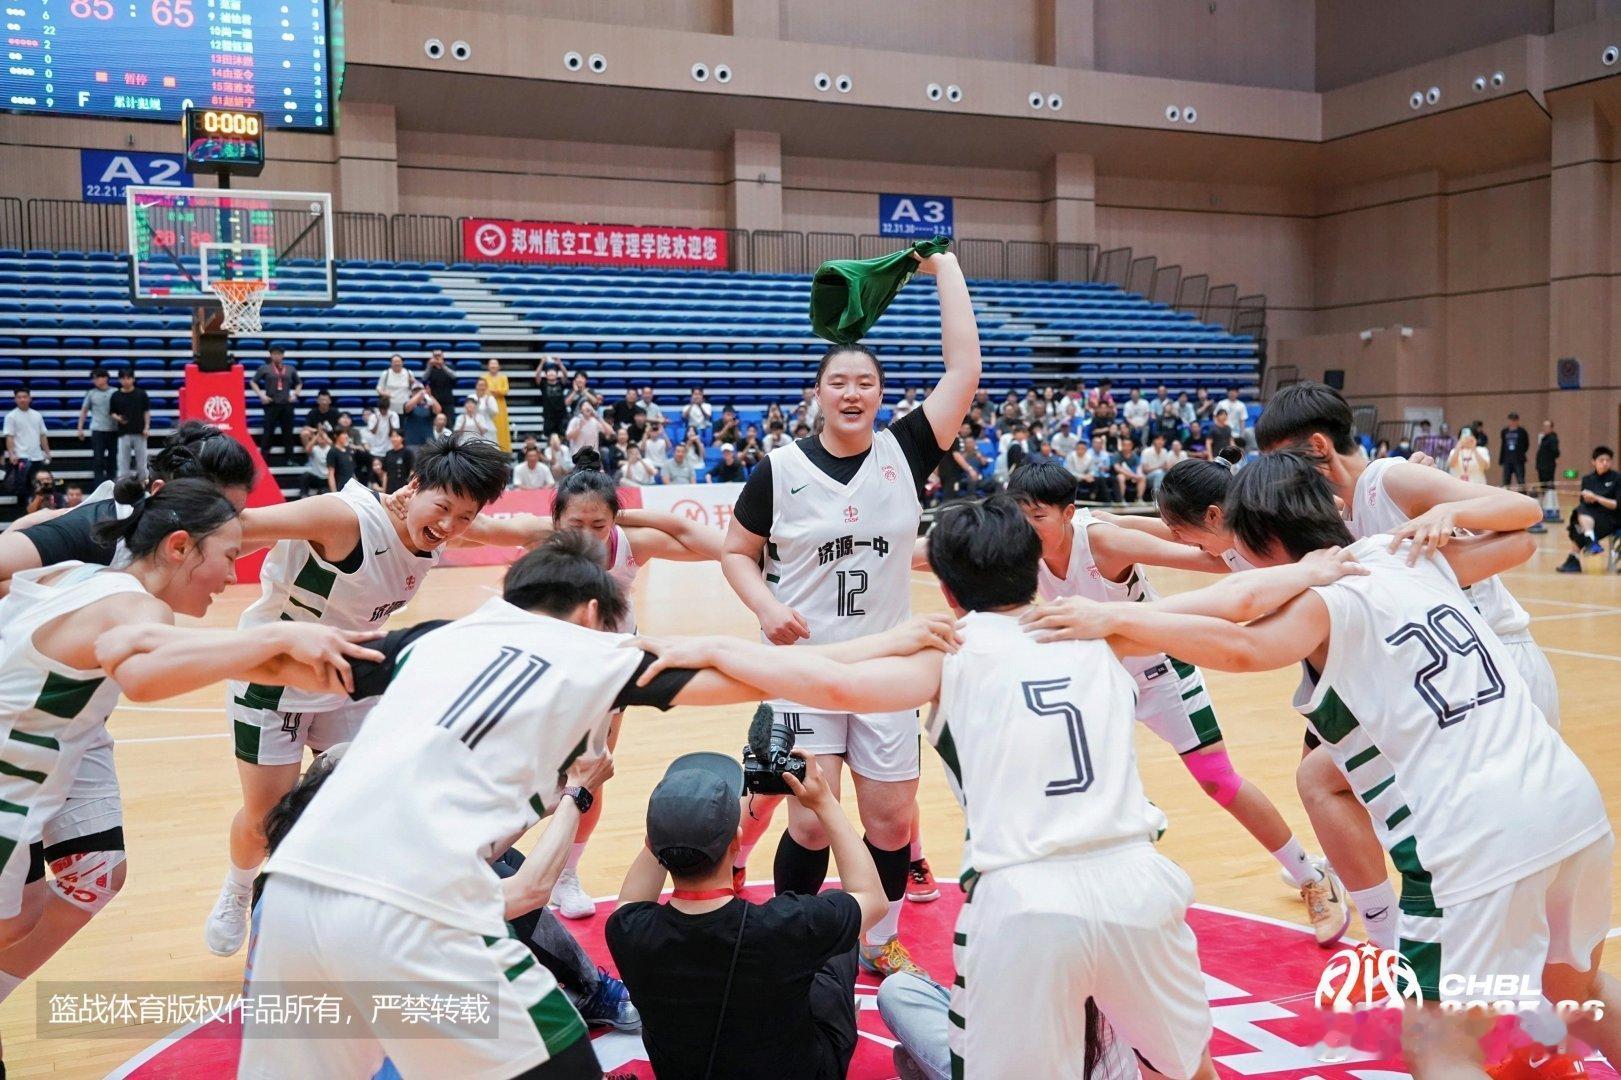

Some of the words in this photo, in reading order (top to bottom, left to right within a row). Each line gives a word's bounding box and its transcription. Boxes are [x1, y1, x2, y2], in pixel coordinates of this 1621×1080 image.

[151, 0, 196, 28] 65
[43, 26, 56, 36] 22
[43, 40, 51, 50] 2
[78, 91, 91, 107] F
[99, 155, 182, 186] A2
[890, 198, 945, 223] A3
[511, 228, 718, 261] 郑州航空工业管理学院欢迎您
[817, 535, 889, 567] 济源一中
[836, 569, 869, 617] 12
[1385, 604, 1506, 730] 29
[436, 645, 552, 751] 11
[1021, 676, 1095, 797] 5
